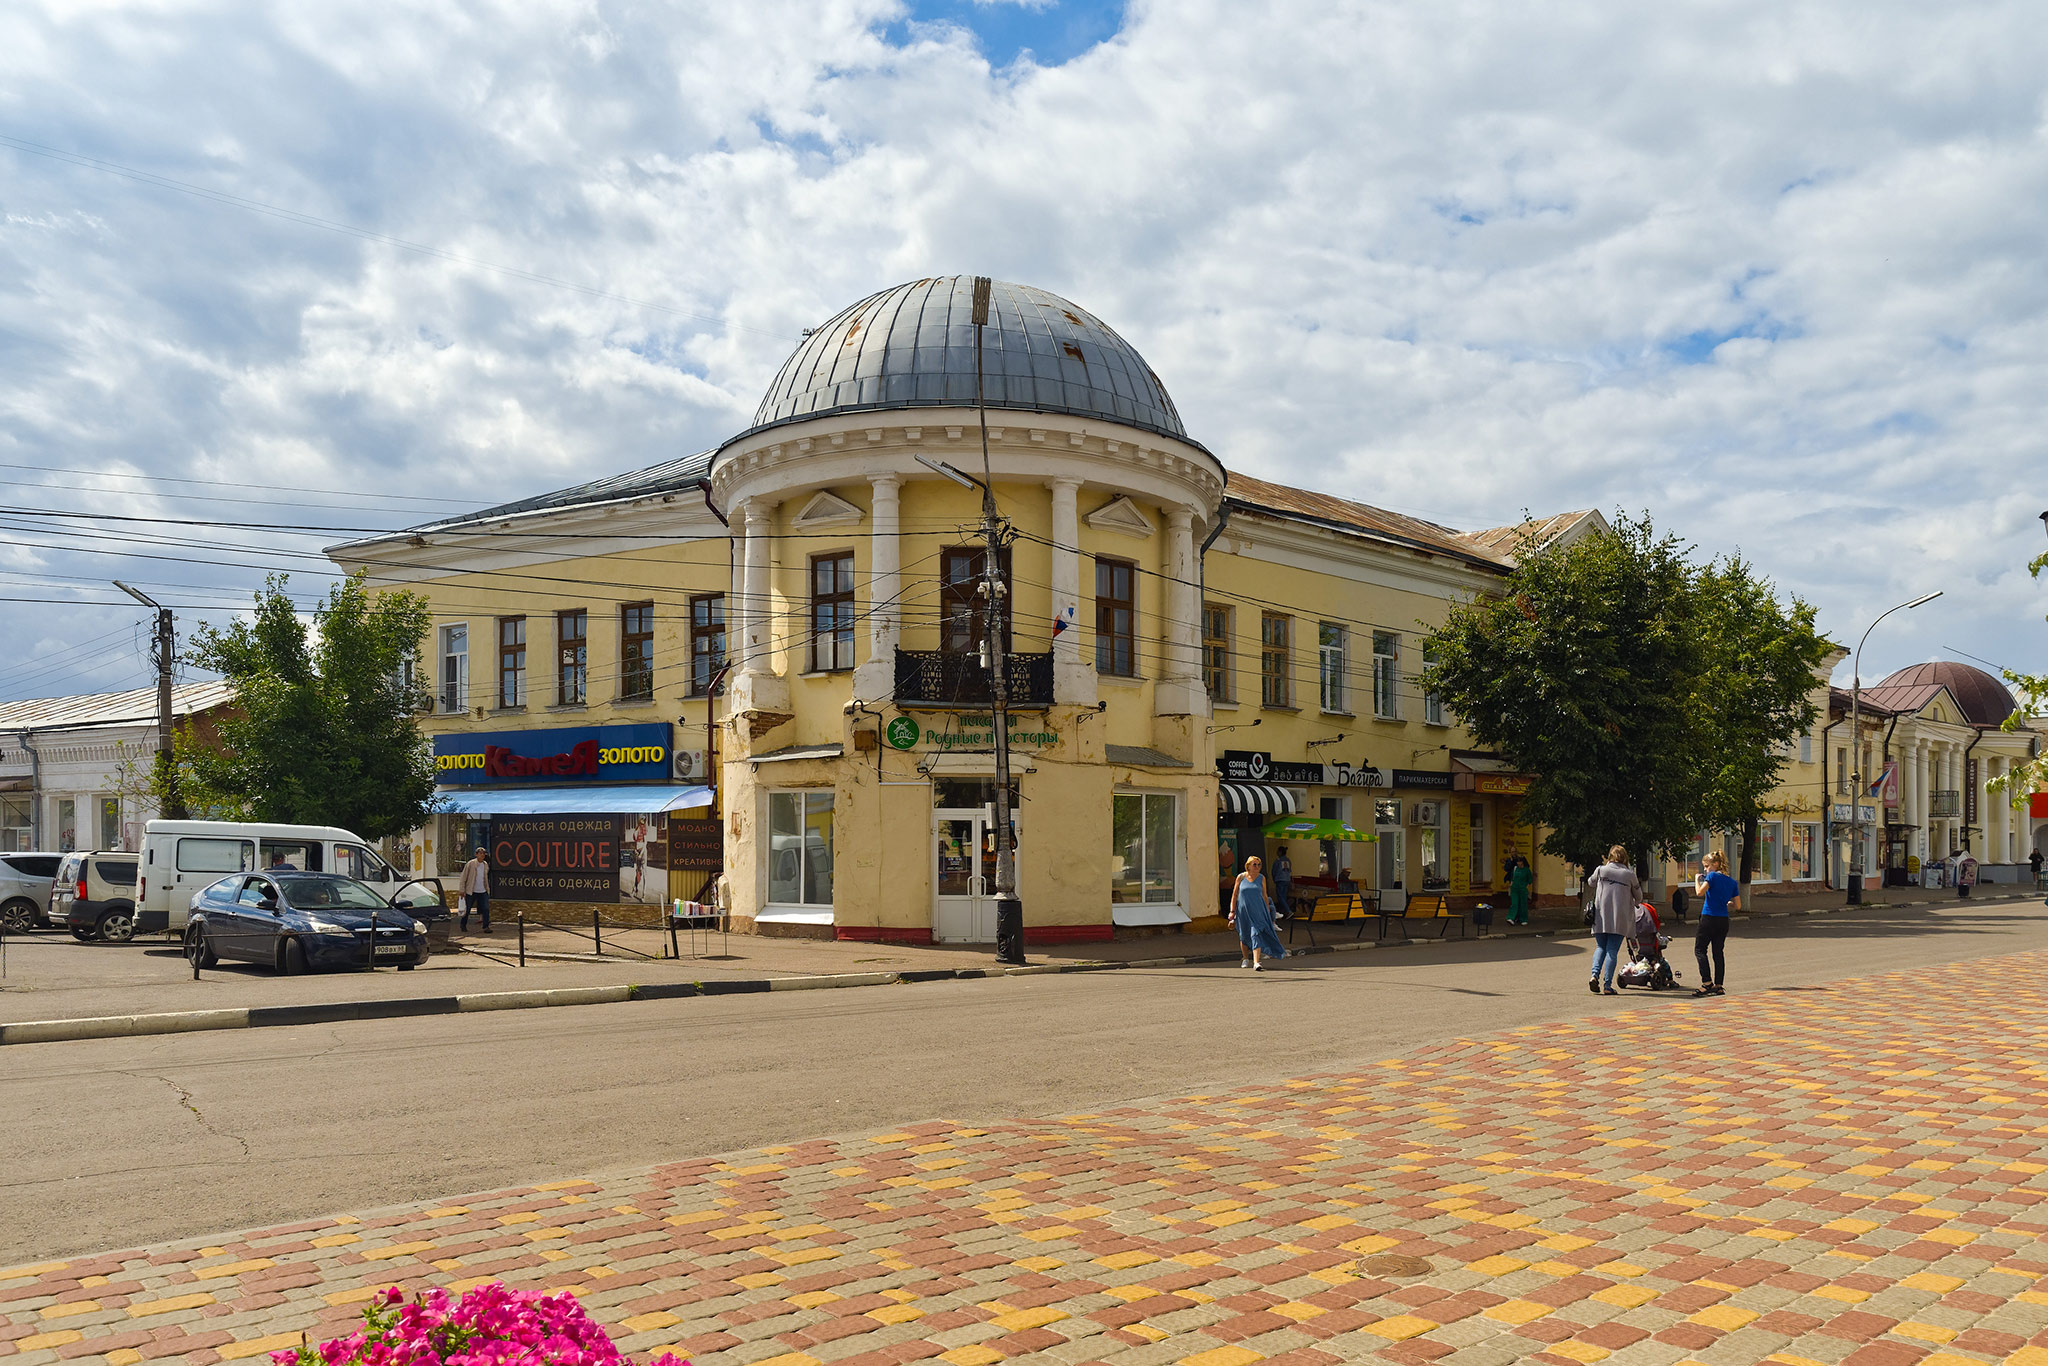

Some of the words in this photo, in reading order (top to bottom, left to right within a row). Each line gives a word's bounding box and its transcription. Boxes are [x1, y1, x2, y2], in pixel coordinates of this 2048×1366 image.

[925, 729, 981, 750] Родные
[985, 732, 1058, 749] посторы
[598, 746, 665, 765] ЗОЛОТО
[1228, 760, 1248, 769] COFFEE
[1228, 769, 1247, 777] ТОЧКА
[1332, 758, 1384, 796] Багира
[1398, 775, 1448, 785] ПАРИКМАХЕРСКАЯ
[499, 820, 555, 835] мужская
[559, 819, 612, 832] одежда
[677, 824, 717, 833] МОДНО
[674, 841, 721, 850] СТИЛЬНО
[495, 840, 611, 868] COUTURE
[498, 875, 553, 888] женская
[558, 876, 611, 890] одежда
